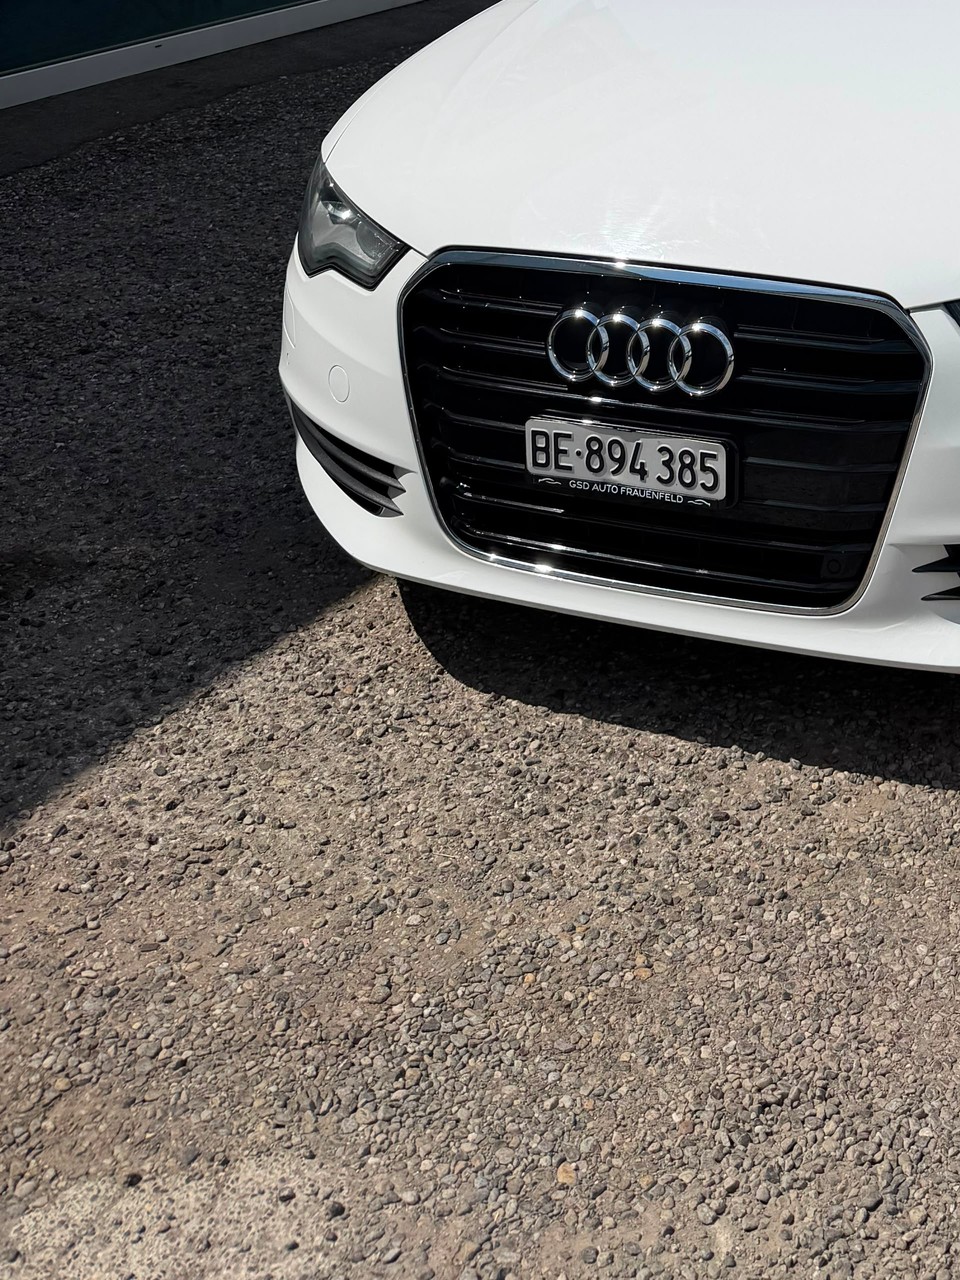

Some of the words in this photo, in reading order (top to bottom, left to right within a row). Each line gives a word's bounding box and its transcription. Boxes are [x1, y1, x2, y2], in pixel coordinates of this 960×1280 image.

[569, 480, 590, 491] GSD
[591, 483, 619, 494] AUTO
[620, 486, 684, 504] FRAUENFELD
